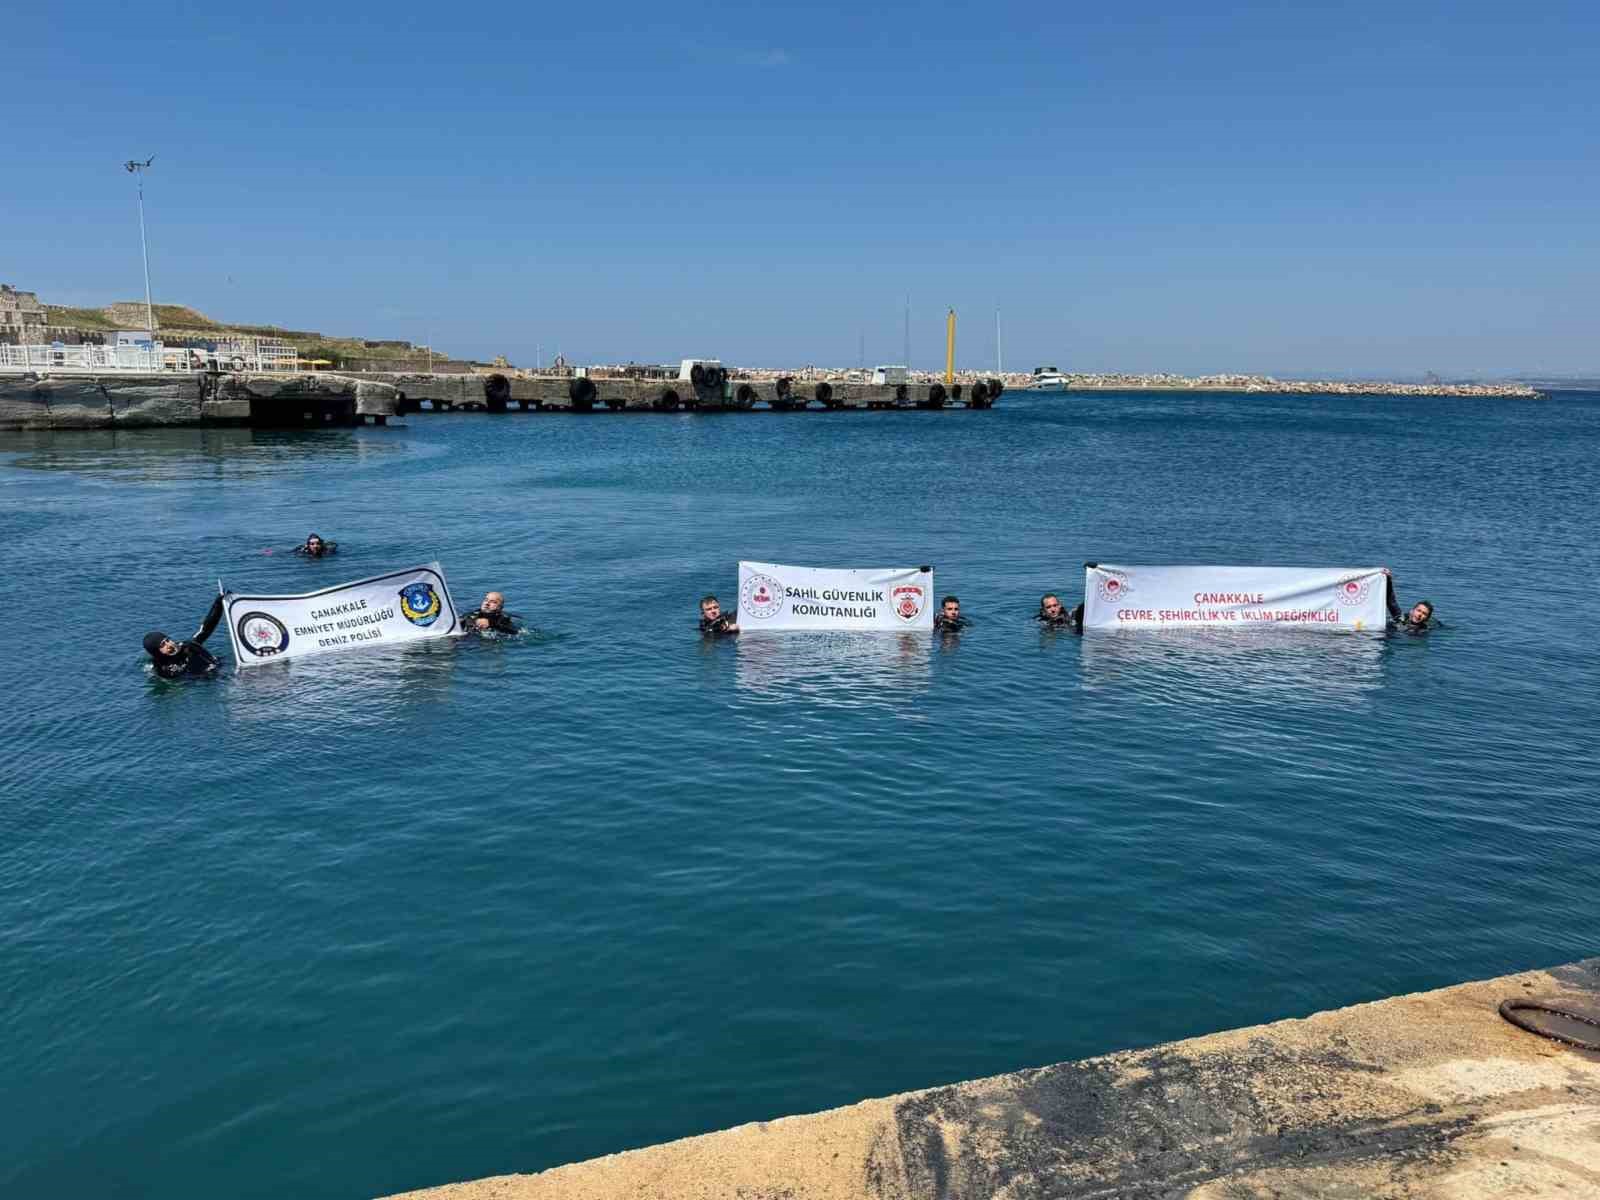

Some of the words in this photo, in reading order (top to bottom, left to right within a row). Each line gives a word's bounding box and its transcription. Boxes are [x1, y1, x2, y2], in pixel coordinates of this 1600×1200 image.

[785, 586, 820, 600] SAHİL
[822, 587, 883, 601] GÜVENLİK
[1194, 593, 1264, 606] ÇANAKKALE
[311, 600, 368, 620] ÇANAKKALE
[792, 604, 876, 618] KOMUTANLIĞI
[1117, 608, 1156, 622] ÇEVRE,
[1159, 608, 1219, 623] ŞEHİRCİLİK
[1221, 611, 1235, 620] VE
[1241, 608, 1272, 621] İKLİM
[1275, 608, 1339, 623] DEĞİŞİKLİĞİ
[294, 624, 335, 636] EMNİYET
[337, 609, 394, 630] MÜDÜRLÜĞÜ
[319, 635, 347, 647] DENİZ
[350, 628, 382, 642] POLİSİ
